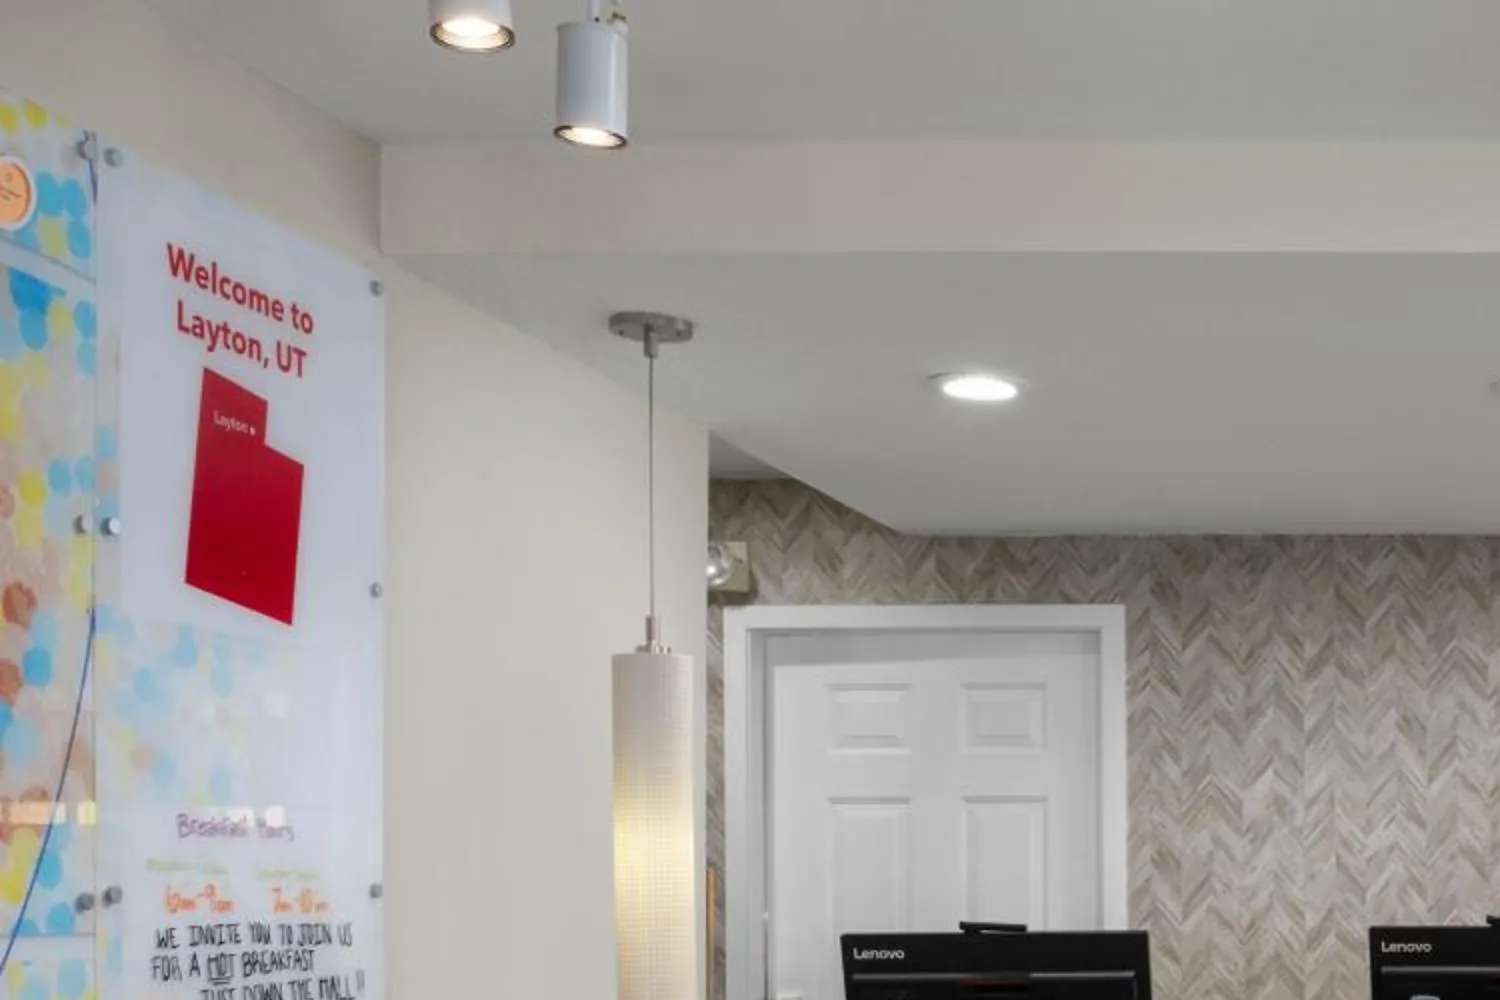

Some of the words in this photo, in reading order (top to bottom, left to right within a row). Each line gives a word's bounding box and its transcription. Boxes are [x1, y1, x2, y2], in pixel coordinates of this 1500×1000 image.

[166, 242, 284, 326] Welcome
[290, 301, 315, 335] to
[176, 298, 270, 369] Layton,
[276, 342, 307, 378] UT
[213, 409, 249, 433] Layton
[155, 927, 180, 949] WE
[188, 922, 243, 947] INVITE
[248, 921, 271, 945] YOU
[279, 922, 294, 946] TO
[297, 922, 333, 948] JOIN
[337, 921, 354, 948] US
[1380, 941, 1433, 953] Lenovo
[151, 955, 183, 982] FOR
[188, 952, 201, 978] A
[207, 953, 236, 979] HOT
[241, 948, 316, 978] BREAKFAST
[853, 948, 905, 960] Lenovo
